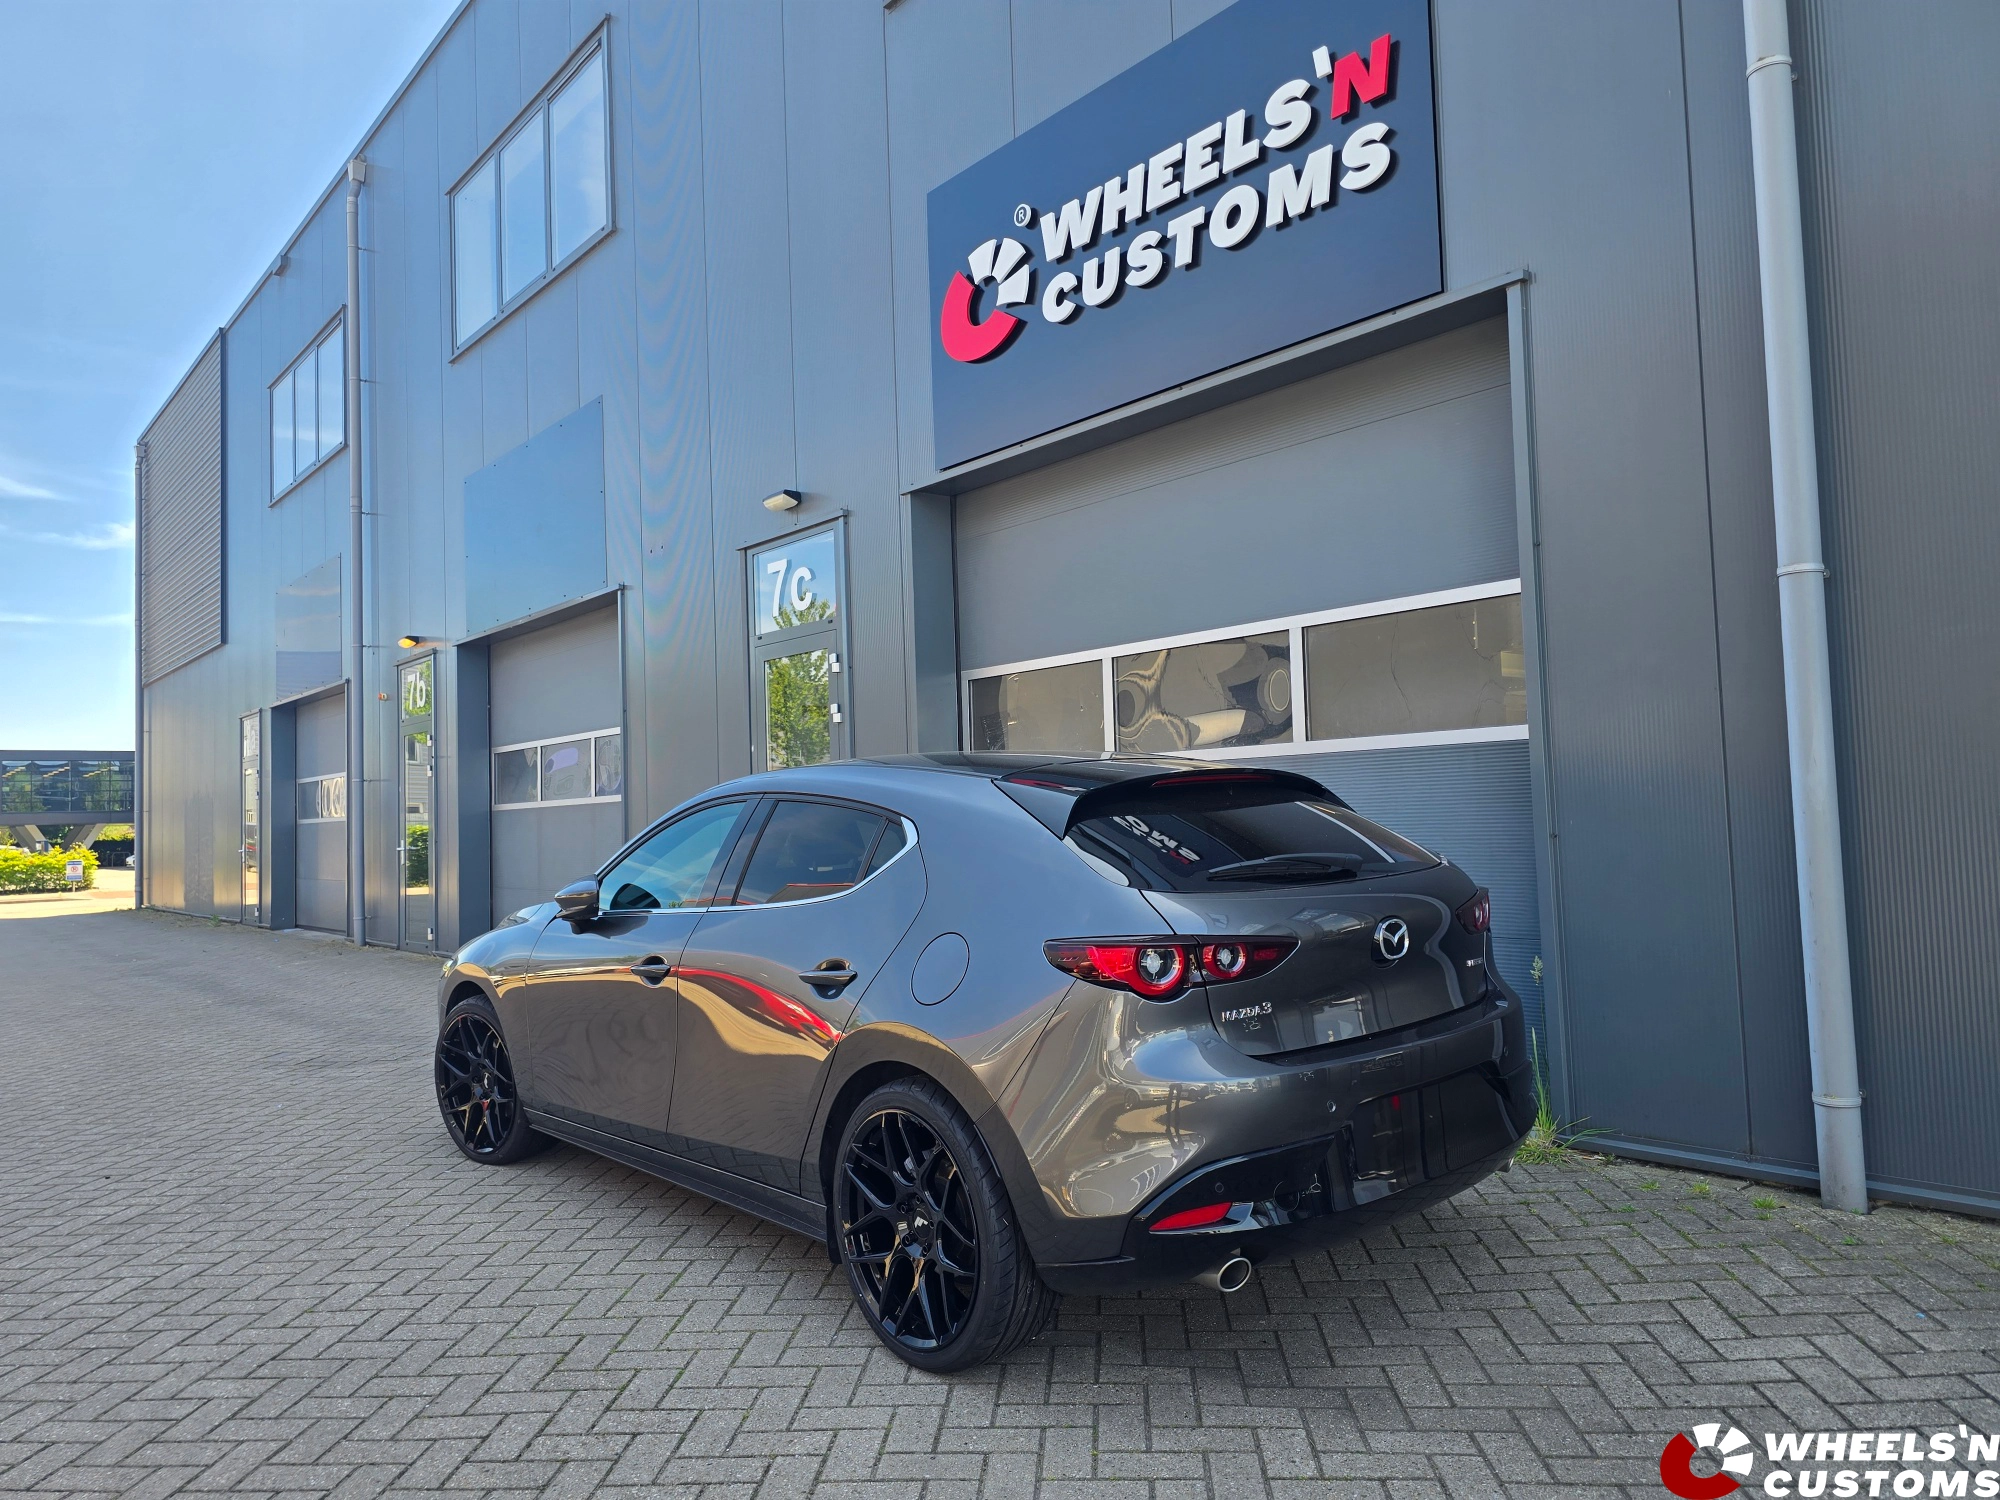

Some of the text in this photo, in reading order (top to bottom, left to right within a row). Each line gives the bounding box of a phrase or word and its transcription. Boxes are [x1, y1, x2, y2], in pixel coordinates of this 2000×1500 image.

[1040, 33, 1392, 262] WHEELS'N
[1041, 122, 1391, 324] CUSTOMS
[407, 671, 426, 710] 7b
